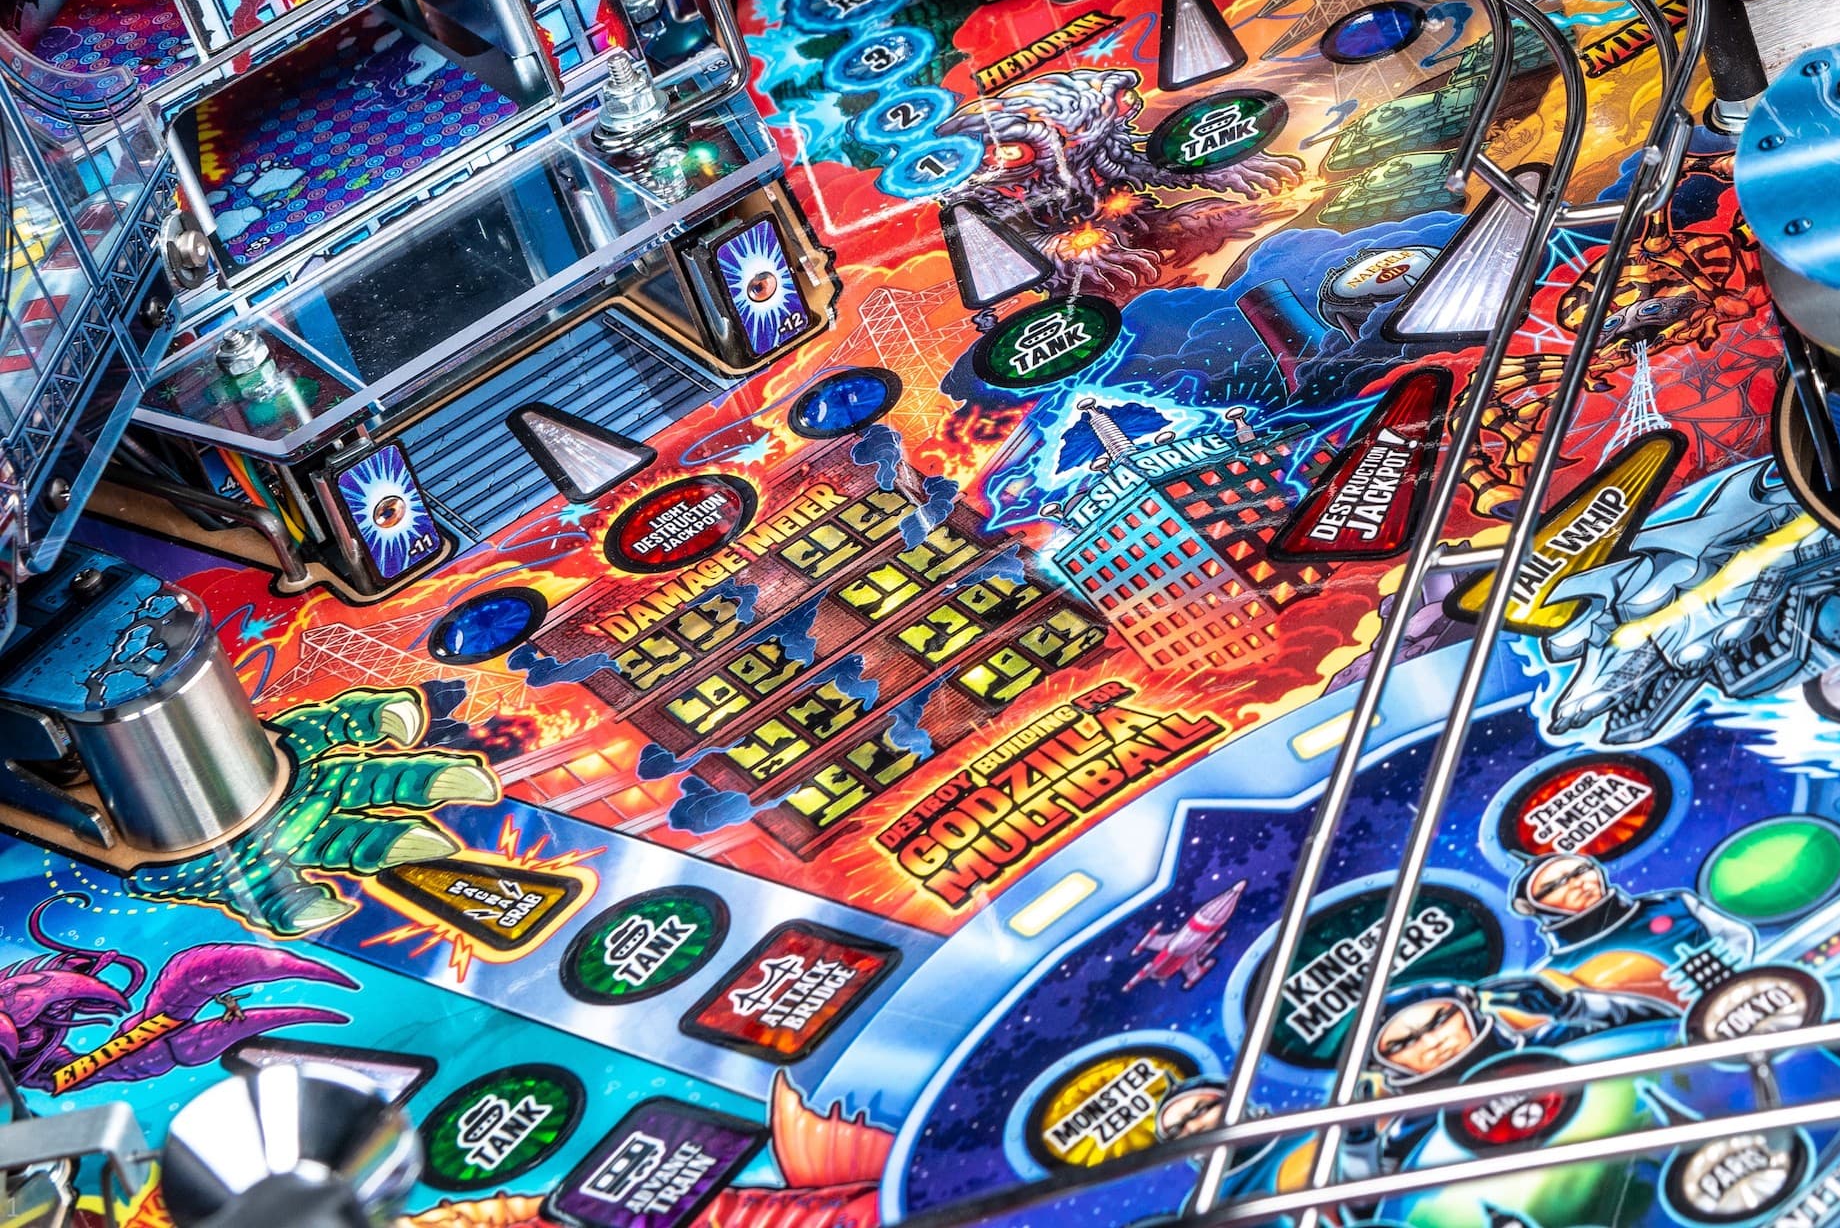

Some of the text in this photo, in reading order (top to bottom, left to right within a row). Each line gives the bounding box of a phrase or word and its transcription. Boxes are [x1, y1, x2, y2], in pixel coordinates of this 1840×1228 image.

[863, 47, 893, 71] 3
[979, 14, 1107, 88] HEDORAH
[889, 105, 922, 128] 2
[1185, 120, 1256, 158] TANK
[918, 157, 945, 176] 1
[1347, 251, 1415, 288] NAEGELE
[1380, 265, 1407, 282] OIL
[778, 313, 804, 335] -12
[1013, 324, 1088, 372] TANK
[1065, 434, 1234, 526] TESLA STRIKE
[1310, 447, 1389, 540] DESTRUCTION
[409, 534, 432, 556] -11
[632, 492, 728, 555] DESTRUCTION
[649, 500, 692, 529] LIGHT
[661, 511, 723, 552] JACKPOT
[1550, 488, 1627, 552] WHIP
[598, 483, 850, 643] DAMAGE METER
[878, 683, 1128, 848] DESTROY BUILDING FOR
[900, 707, 1161, 876] GODZILLA
[924, 715, 1221, 906] MULTIBALL
[1529, 774, 1600, 825] TERROR
[1554, 777, 1625, 830] MECHA
[1557, 785, 1647, 852] GODZILLA
[448, 880, 515, 909] MAGNA
[498, 893, 543, 928] GRAB
[620, 918, 691, 982] TANK
[1286, 942, 1363, 1005] KING
[760, 959, 840, 1028] ATTACK
[780, 964, 857, 1031] BRIDGE
[1717, 987, 1794, 1039] TOKYO
[53, 1012, 184, 1095] EBIRAH
[473, 1098, 546, 1167] TANK
[1052, 1062, 1156, 1147] MONSTER
[1093, 1095, 1150, 1144] ZERO
[627, 1141, 703, 1214] ADVANCE
[644, 1153, 718, 1214] TRAIN
